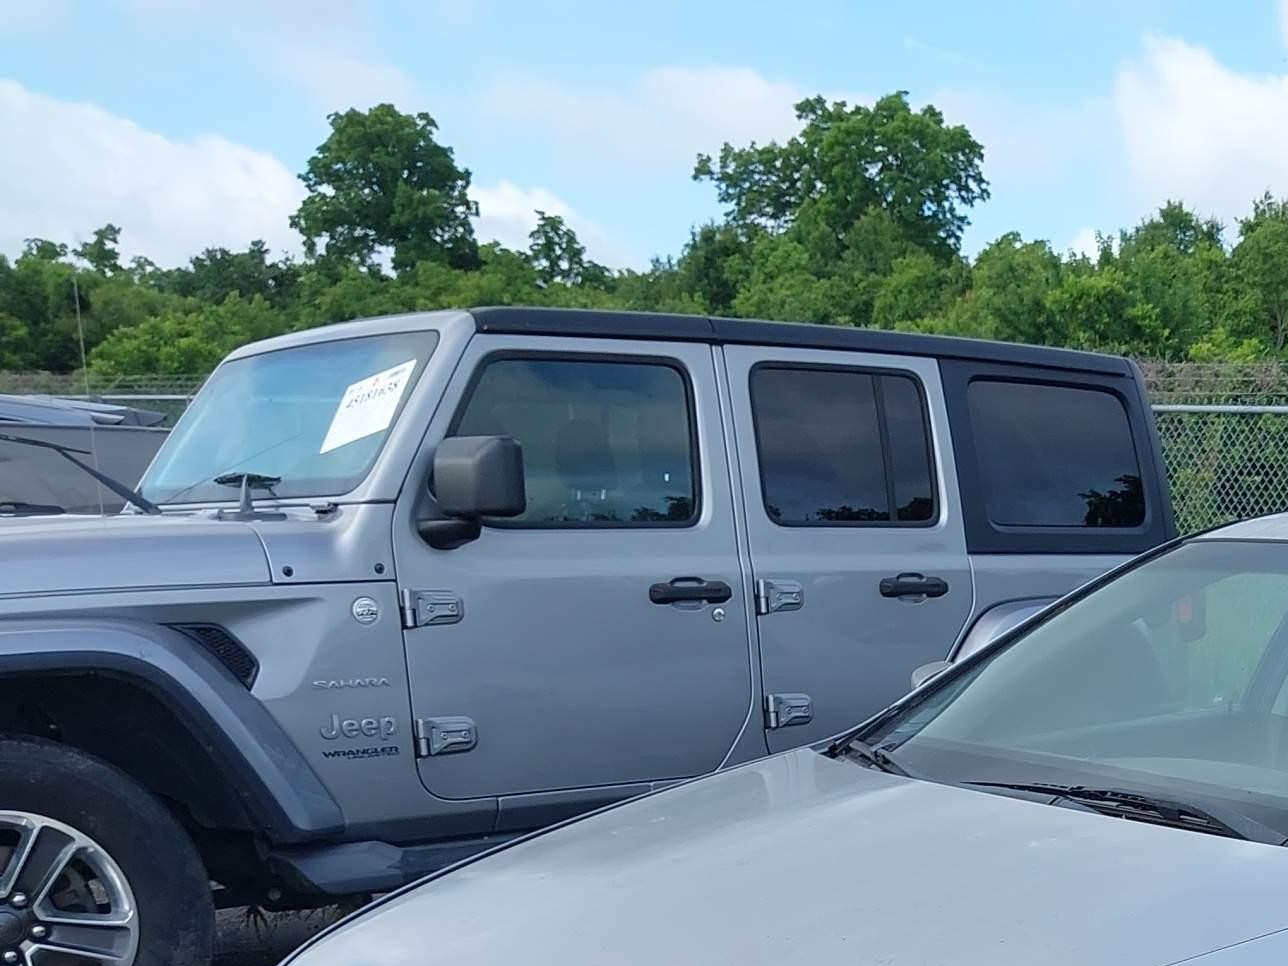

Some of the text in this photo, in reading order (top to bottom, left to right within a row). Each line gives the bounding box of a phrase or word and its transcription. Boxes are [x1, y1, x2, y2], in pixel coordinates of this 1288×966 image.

[312, 677, 390, 690] SAHARA
[320, 713, 399, 741] Jeep
[322, 746, 399, 758] WRANGLER
